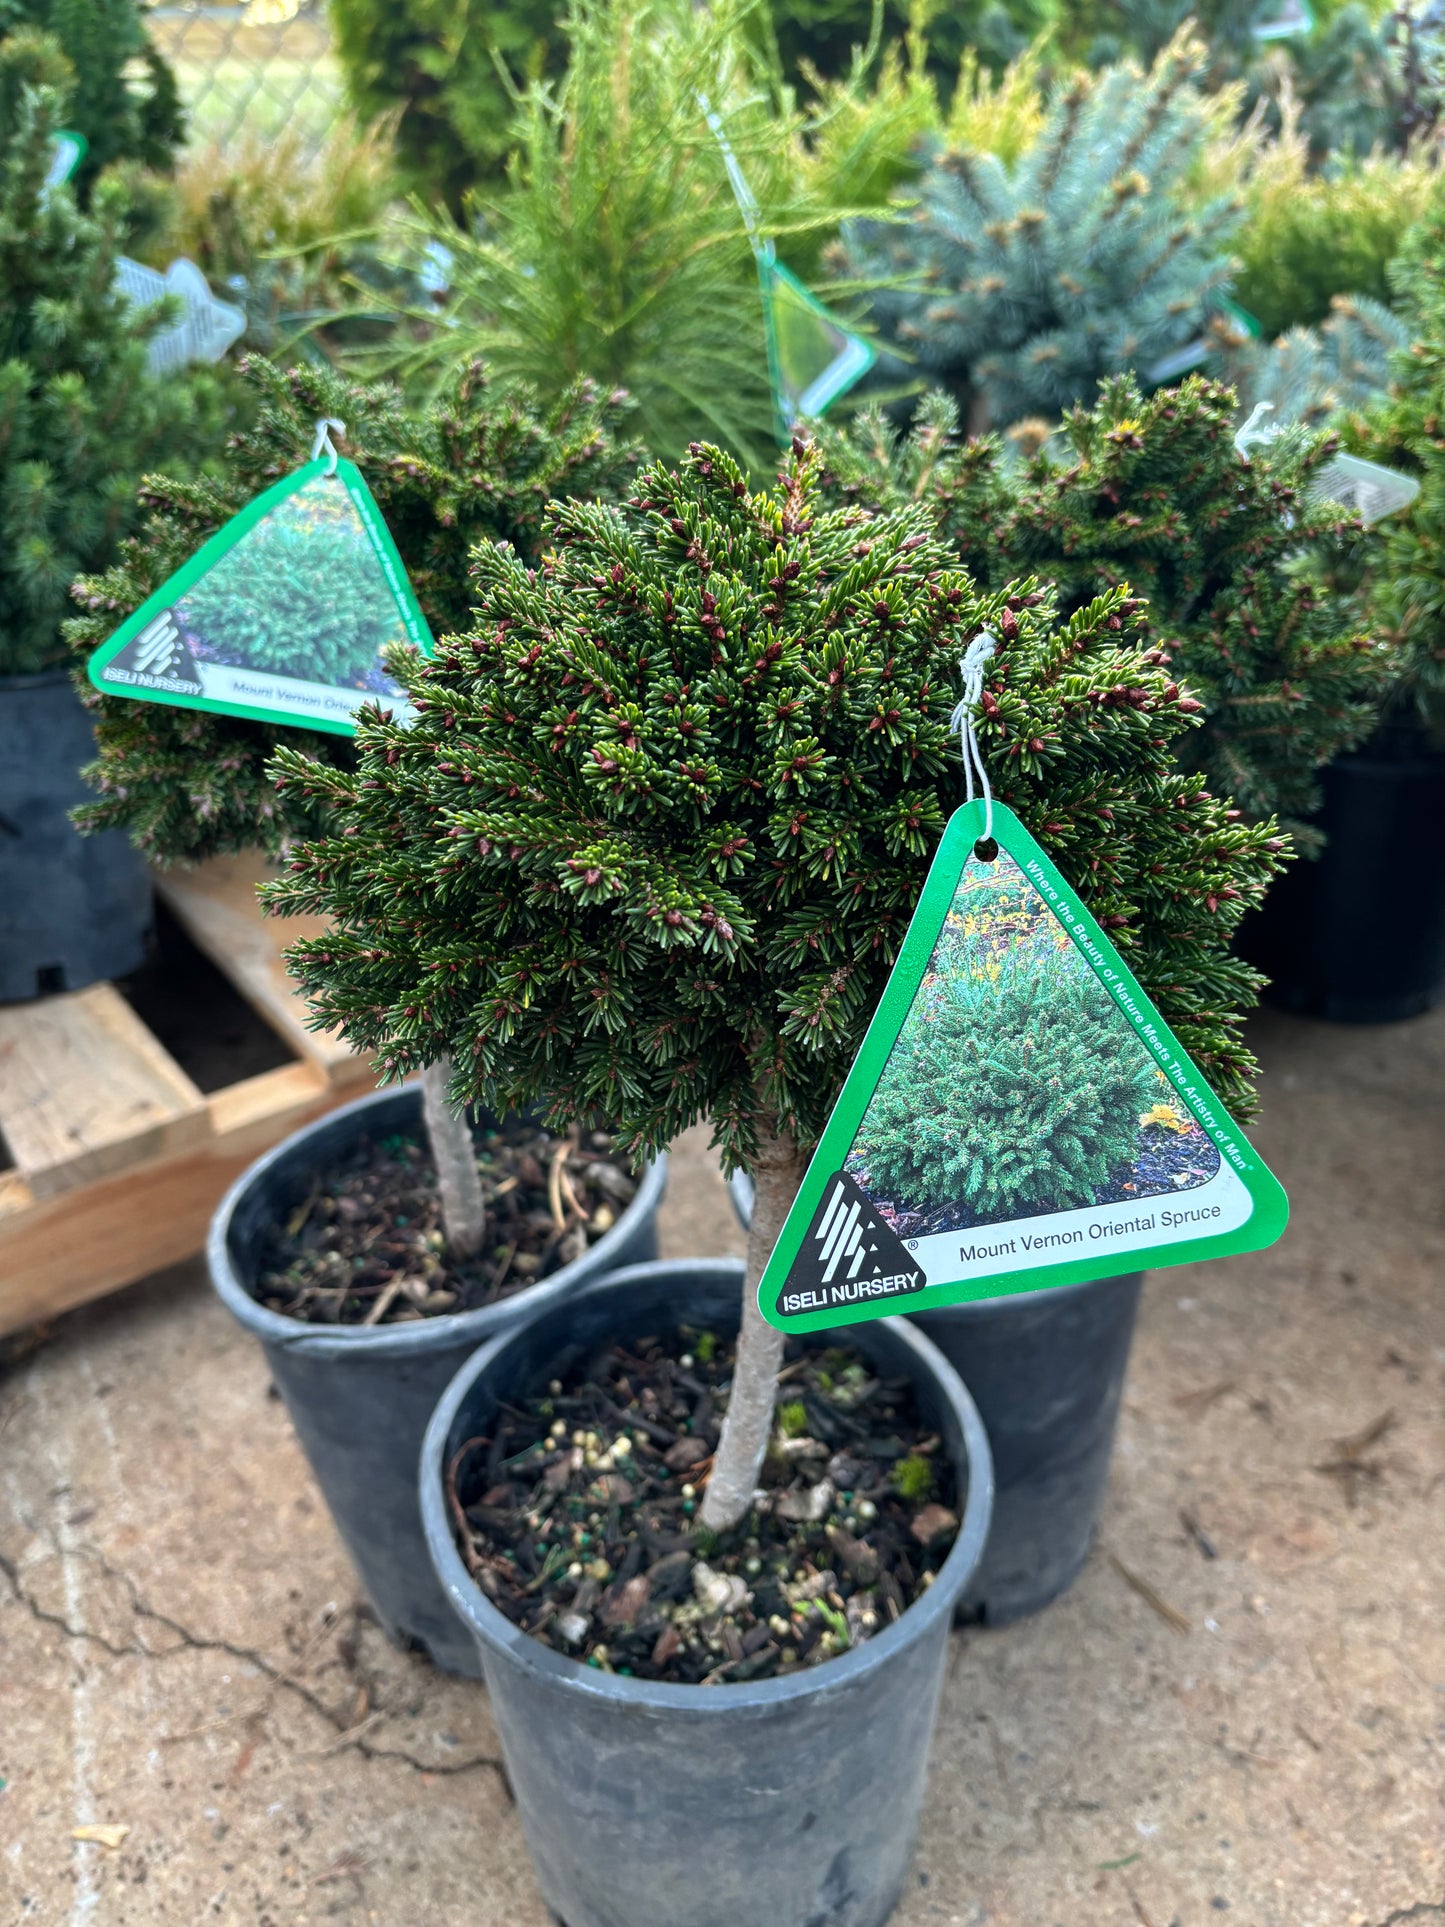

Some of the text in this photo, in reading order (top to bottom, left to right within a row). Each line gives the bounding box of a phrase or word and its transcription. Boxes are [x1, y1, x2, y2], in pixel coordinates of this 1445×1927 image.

[137, 672, 202, 696] NURSERY
[233, 680, 273, 697] Mount
[1026, 859, 1246, 1170] Where the Beauty of Nature Meets The Artistry of Man
[959, 1205, 1222, 1262] Mount Vernon Oriental Spruce
[783, 1271, 919, 1312] ISELI NURSERY
